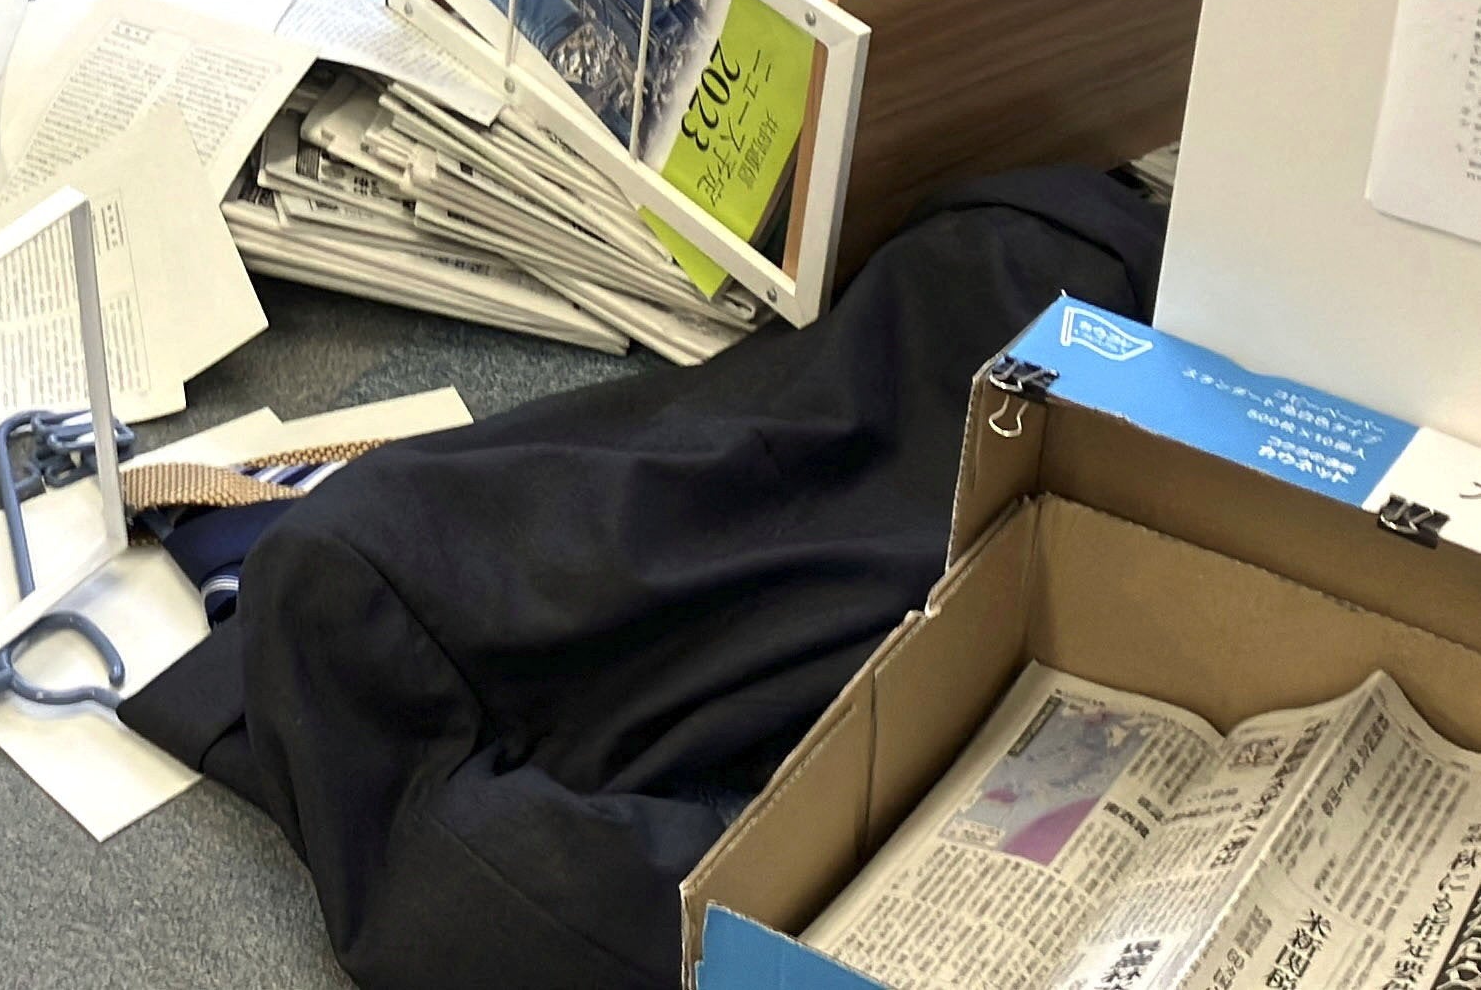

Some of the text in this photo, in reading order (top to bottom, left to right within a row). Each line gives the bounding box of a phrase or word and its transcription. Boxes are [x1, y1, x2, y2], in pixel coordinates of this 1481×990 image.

[682, 39, 742, 153] 2023
[695, 49, 773, 207] ニュース予定
